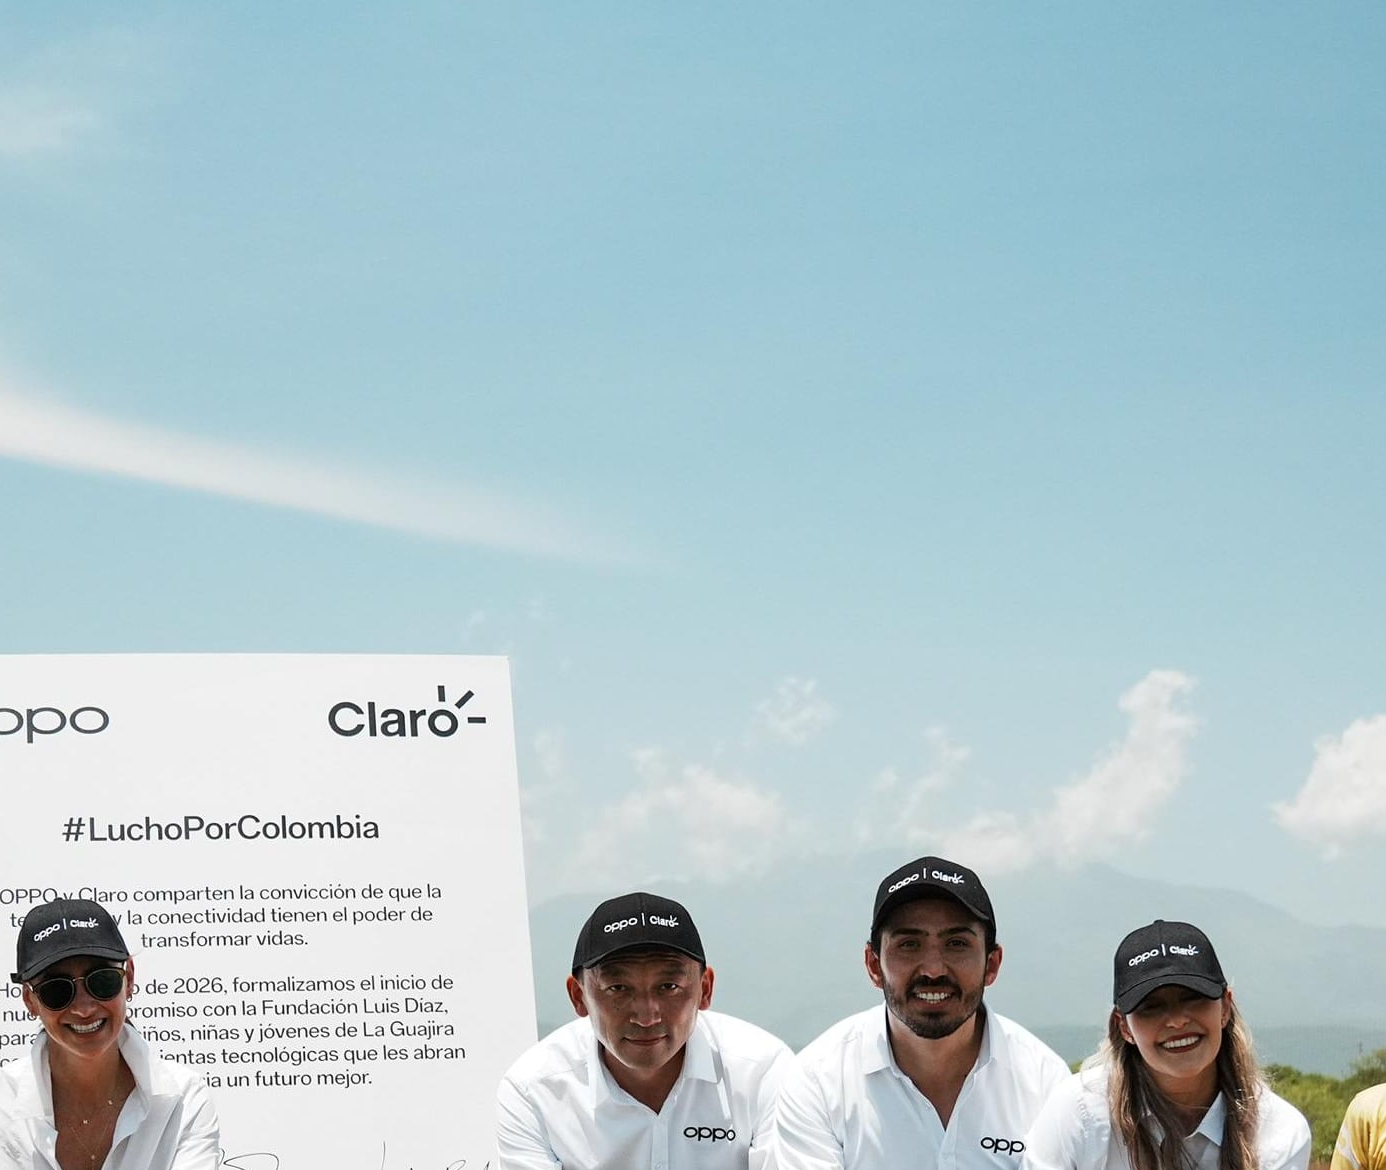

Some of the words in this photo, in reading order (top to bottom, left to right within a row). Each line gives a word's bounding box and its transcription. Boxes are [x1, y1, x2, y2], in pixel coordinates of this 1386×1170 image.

[329, 700, 459, 738] Claro
[62, 814, 380, 843] #LuchoPorColombia
[888, 873, 919, 893] oppo
[932, 870, 959, 884] Claro
[0, 887, 58, 904] OPPO
[79, 886, 128, 902] Claro
[133, 886, 235, 905] comparten
[240, 885, 255, 900] la
[259, 883, 356, 900] convicción
[361, 883, 384, 899] de
[388, 886, 422, 902] que
[427, 883, 442, 899] la
[127, 909, 143, 925] la
[147, 907, 266, 925] conectividad
[271, 906, 328, 923] tienen
[332, 906, 348, 922] el
[352, 906, 406, 926] poder
[410, 905, 433, 922] de
[604, 917, 638, 933] oppo
[649, 915, 675, 928] Claro
[34, 923, 61, 941] oppo
[140, 931, 252, 948] transformar
[256, 930, 309, 946] vidas.
[1128, 949, 1159, 966] oppo
[145, 978, 169, 995] de
[173, 977, 228, 996] 2026,
[232, 976, 356, 993] formalizamos
[360, 975, 375, 991] el
[380, 974, 427, 991] inicio
[431, 974, 454, 990] de
[127, 1001, 198, 1019] promiso
[202, 1003, 237, 1017] con
[241, 1000, 257, 1016] la
[262, 998, 358, 1016] Fundación
[363, 997, 400, 1014] Luis
[404, 997, 449, 1015] Díaz,
[141, 1024, 186, 1044] iños,
[190, 1024, 240, 1041] niñas
[244, 1028, 255, 1044] y
[258, 1023, 331, 1043] jóvenes
[334, 1022, 358, 1038] de
[363, 1021, 385, 1037] La
[389, 1020, 454, 1041] Guajira
[221, 1046, 339, 1067] tecnológicas
[343, 1049, 378, 1065] que
[382, 1044, 409, 1061] les
[413, 1043, 466, 1060] abran
[226, 1075, 250, 1088] un
[254, 1071, 312, 1087] futuro
[317, 1069, 373, 1089] mejor.
[684, 1126, 736, 1142] oppo
[981, 1136, 1025, 1156] opp
